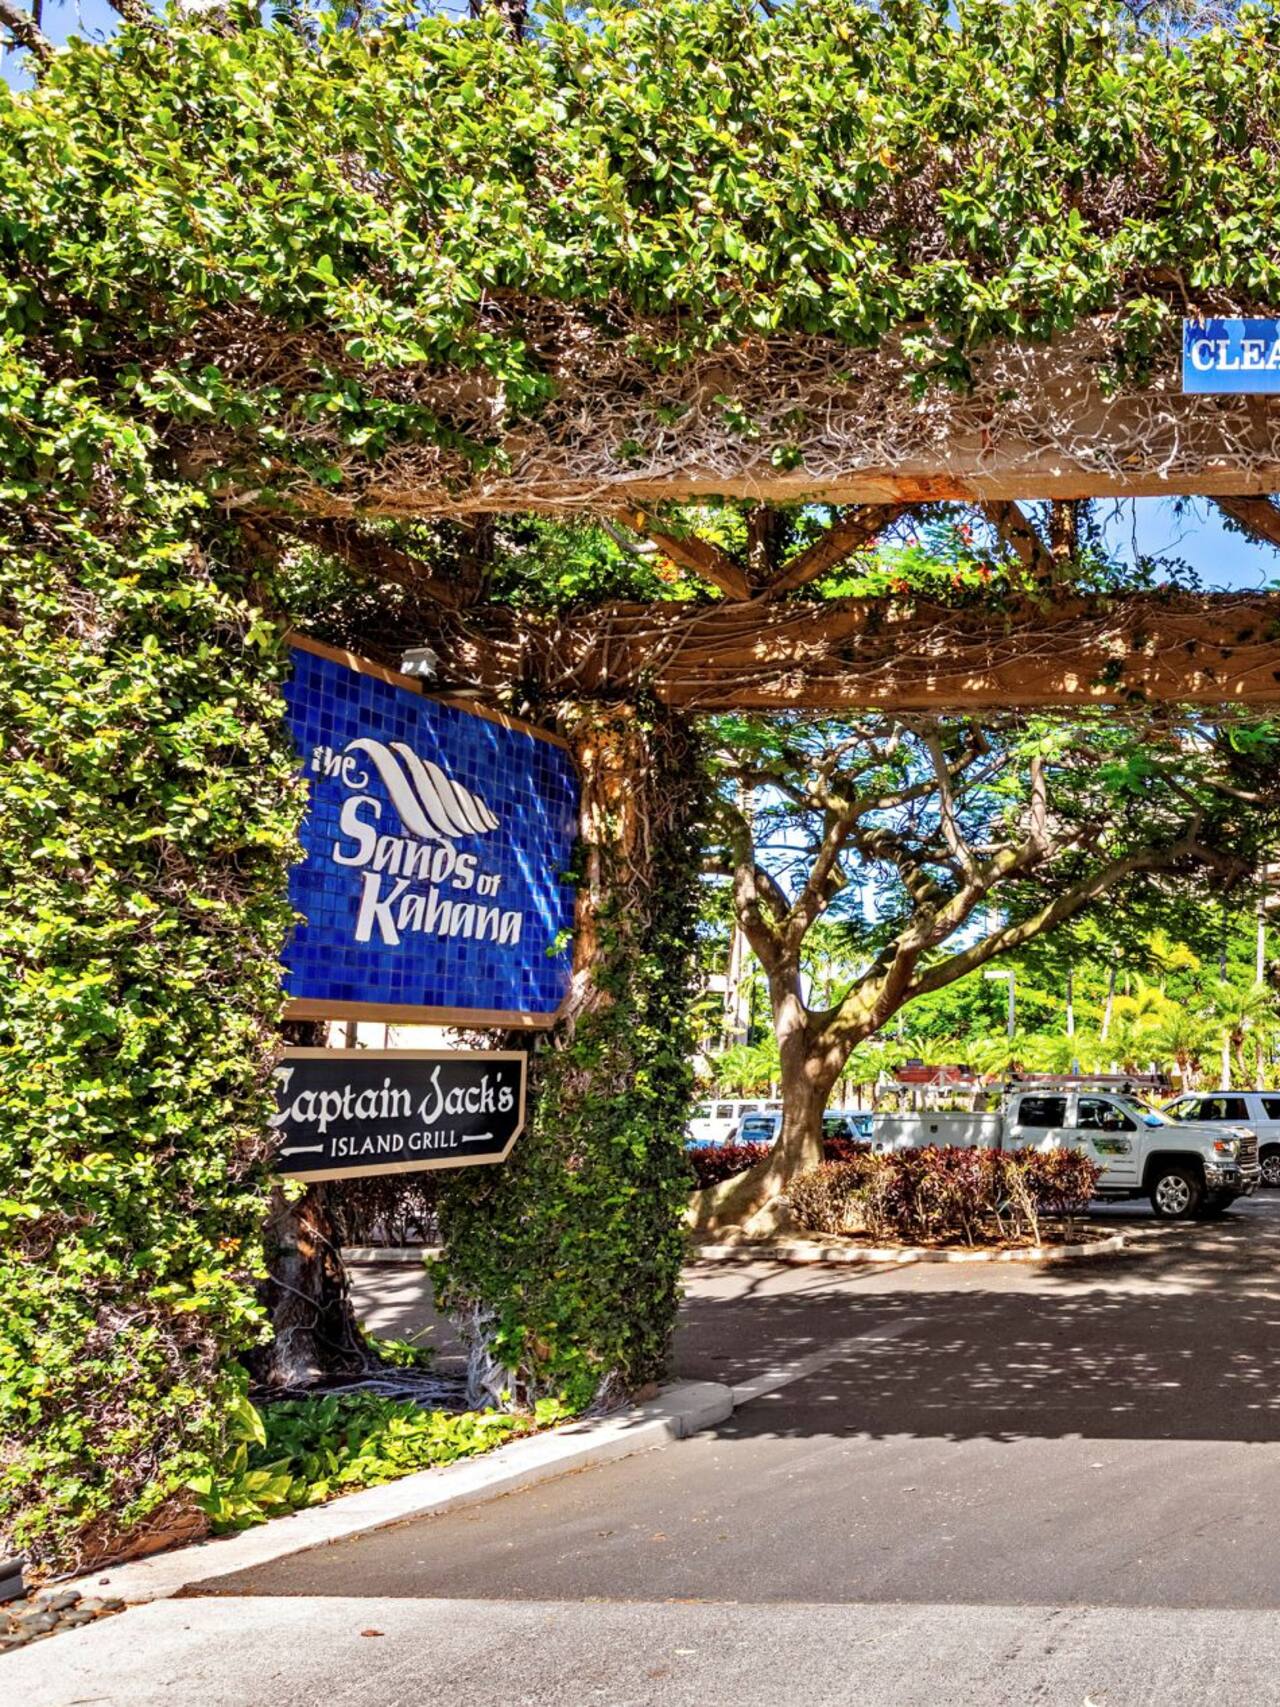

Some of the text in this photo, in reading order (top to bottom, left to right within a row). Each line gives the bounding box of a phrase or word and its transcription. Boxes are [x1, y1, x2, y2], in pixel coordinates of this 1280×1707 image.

[311, 745, 369, 789] the
[332, 795, 502, 898] Sands of
[354, 871, 523, 946] Kahana
[417, 1065, 514, 1125] Jack's
[330, 1130, 458, 1157] ISLAND GRILL
